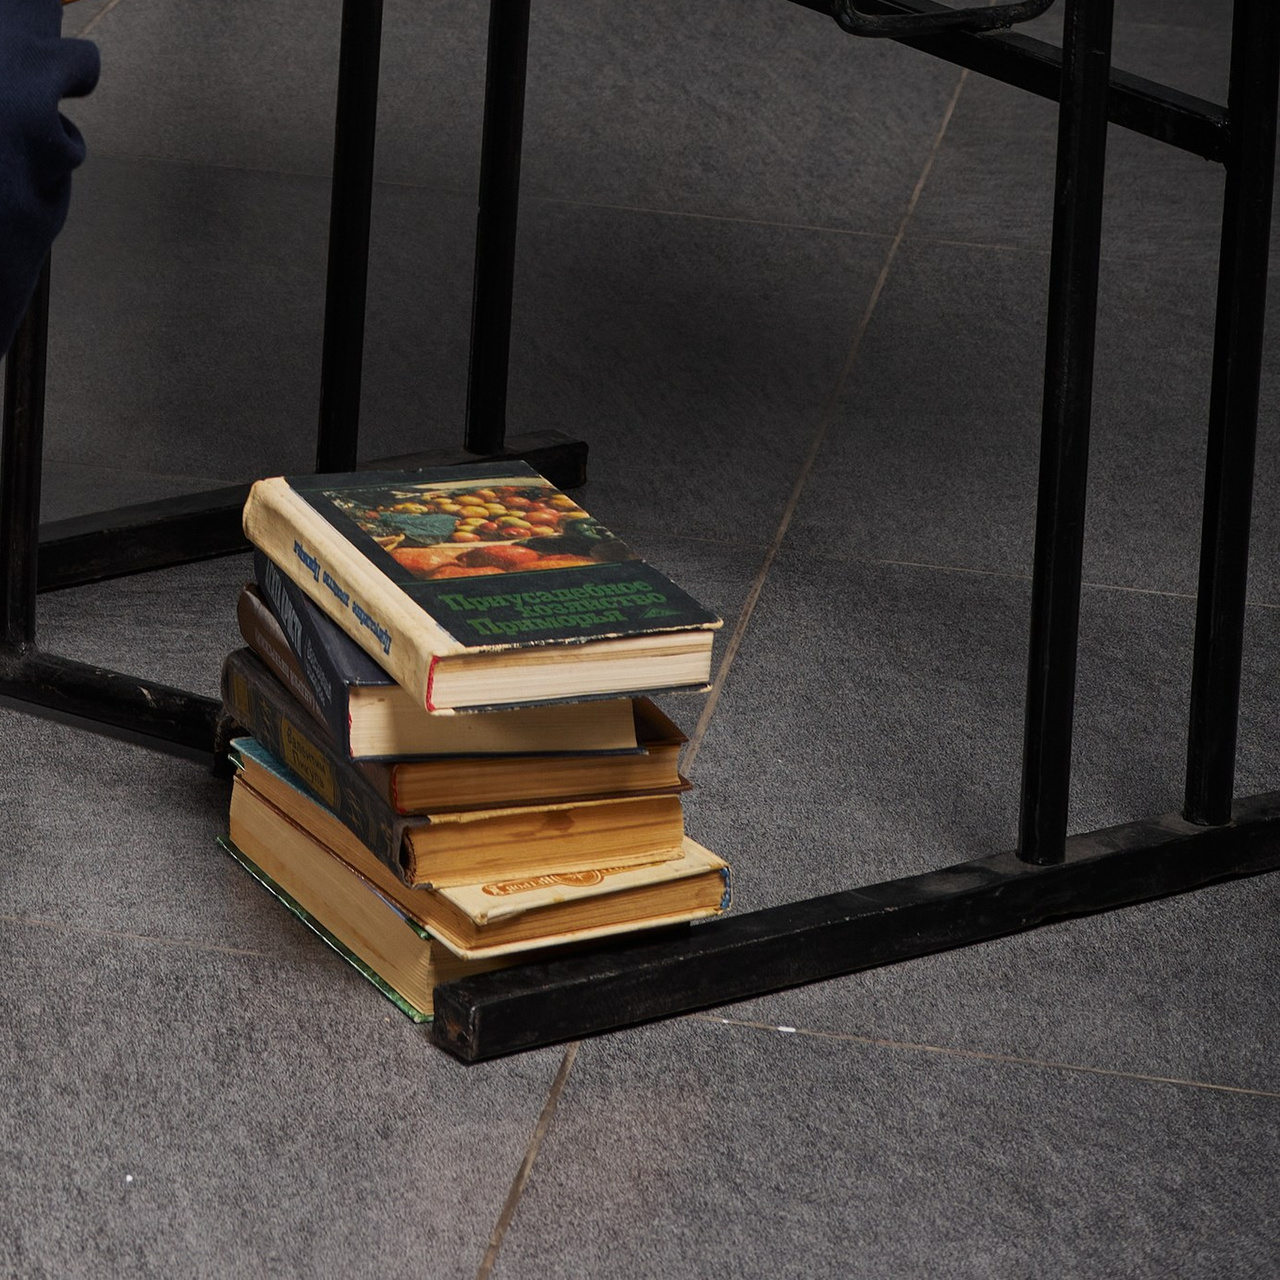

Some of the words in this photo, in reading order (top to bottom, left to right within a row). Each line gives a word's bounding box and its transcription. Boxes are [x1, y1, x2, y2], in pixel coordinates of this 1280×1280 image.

[438, 579, 653, 612] Приусадебное
[519, 591, 668, 617] хозяйство
[468, 609, 624, 636] Приморья
